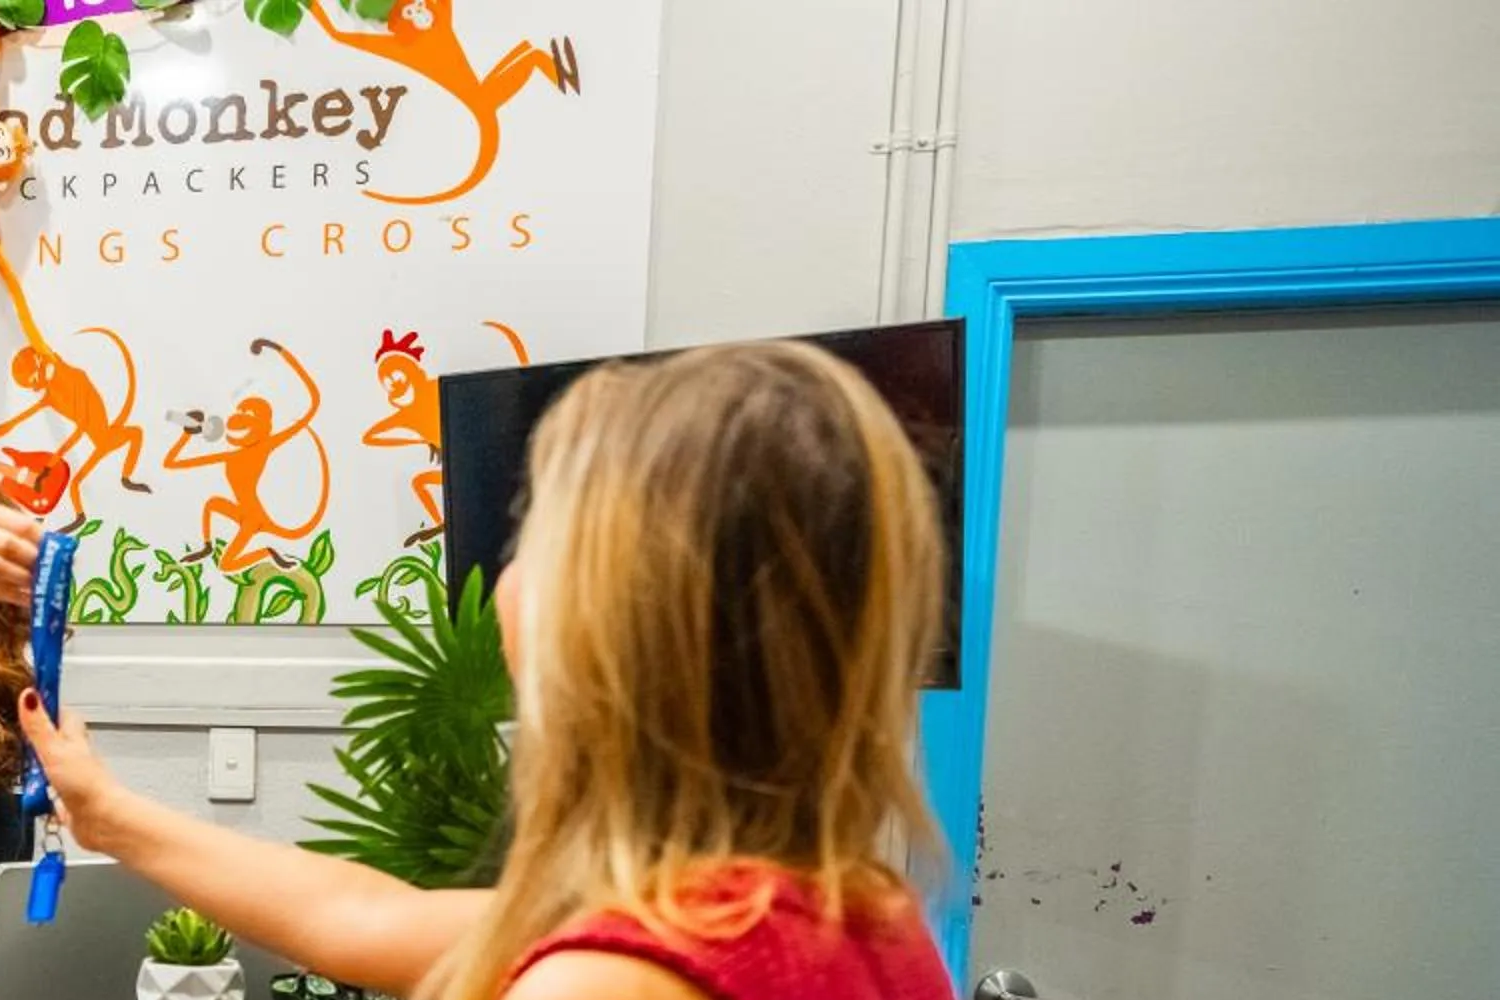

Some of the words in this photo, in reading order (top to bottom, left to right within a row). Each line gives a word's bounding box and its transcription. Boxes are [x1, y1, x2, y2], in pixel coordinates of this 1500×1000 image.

[100, 79, 408, 151] Monkey
[37, 228, 181, 267] NGS
[260, 214, 532, 257] CROSS
